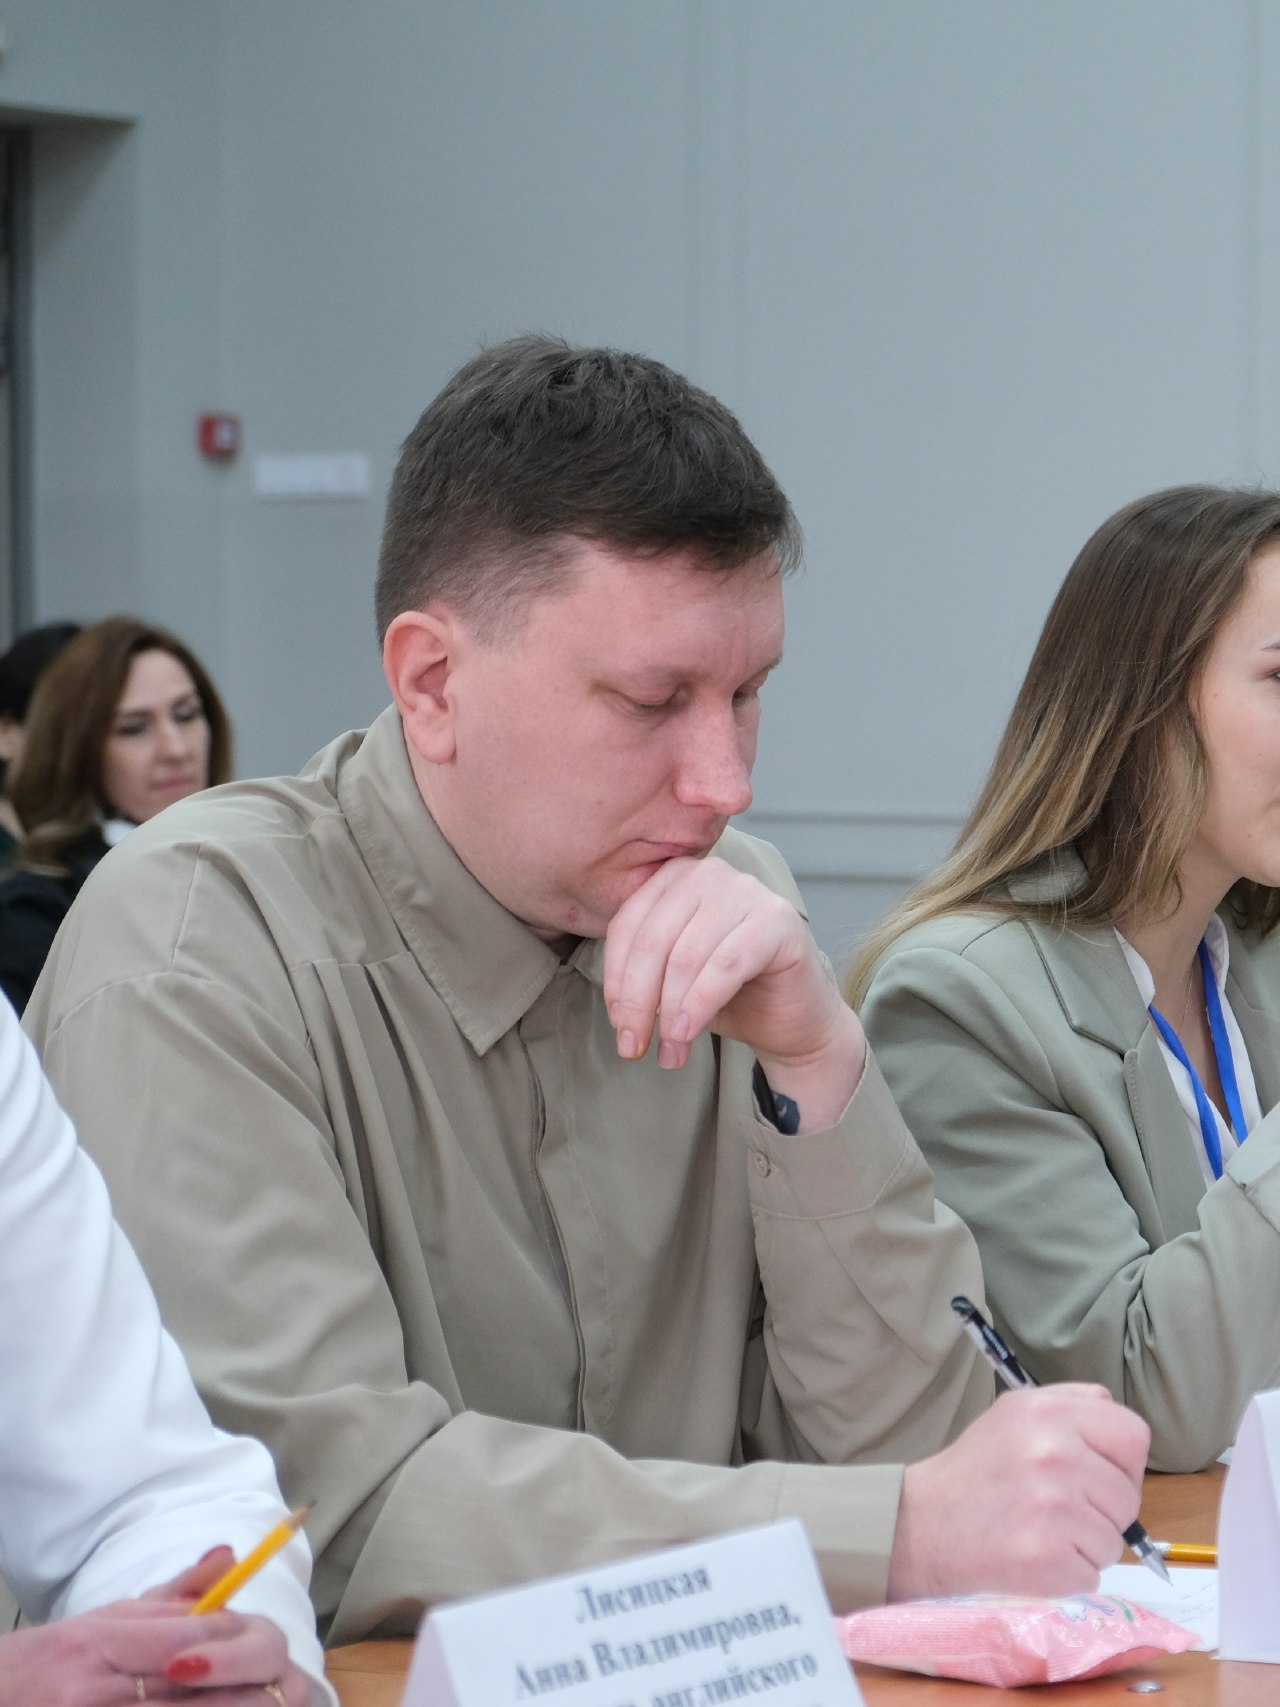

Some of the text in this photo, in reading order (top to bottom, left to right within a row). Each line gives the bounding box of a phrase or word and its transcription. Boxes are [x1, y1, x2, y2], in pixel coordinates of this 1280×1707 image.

[576, 1567, 712, 1625] Лисицкая
[514, 1602, 803, 1701] Анна Владимировна,
